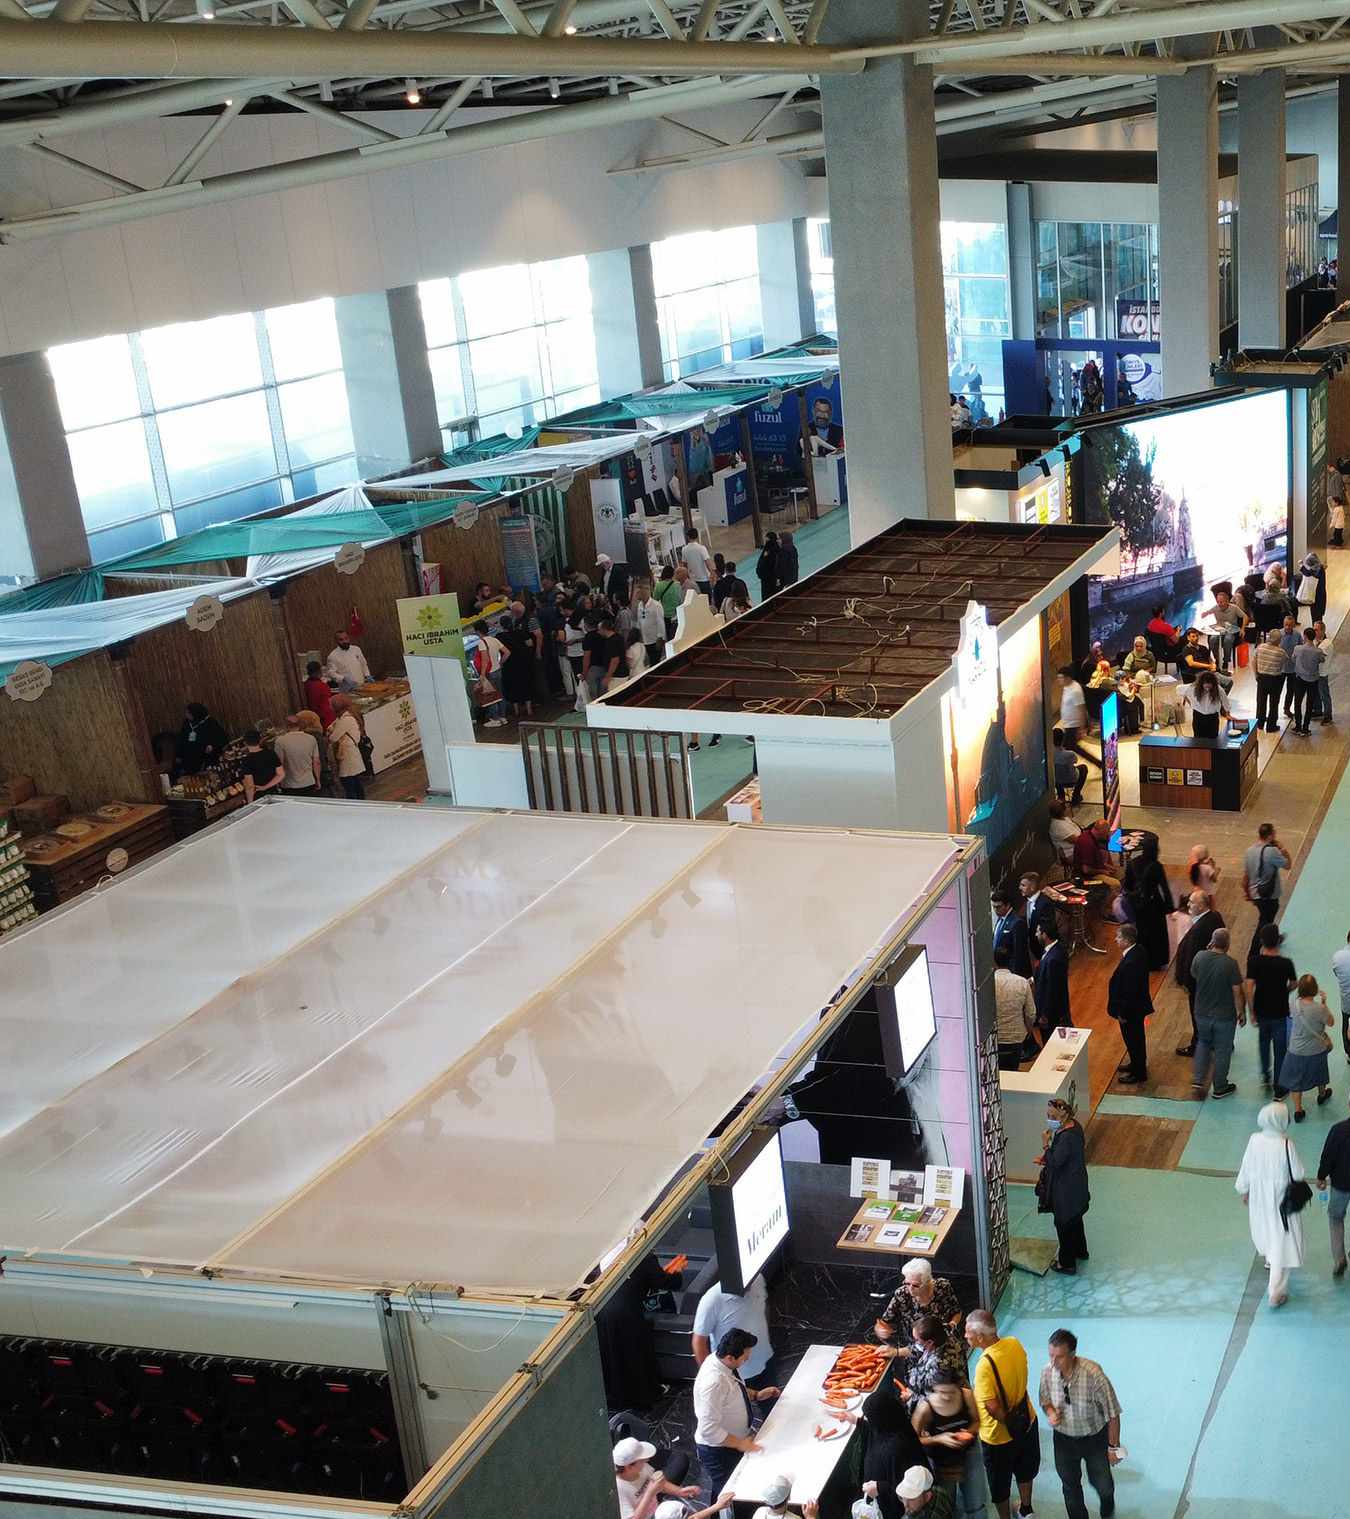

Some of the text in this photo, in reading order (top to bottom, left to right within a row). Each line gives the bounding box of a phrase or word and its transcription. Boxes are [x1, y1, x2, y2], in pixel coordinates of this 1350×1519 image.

[1130, 304, 1160, 314] İSTABU
[755, 411, 782, 423] fuzul
[734, 492, 747, 506] fuzul
[197, 604, 212, 614] ADEM
[196, 612, 215, 624] BADEM
[406, 629, 458, 641] HACI İBRAHİM
[747, 1206, 781, 1255] Meram
